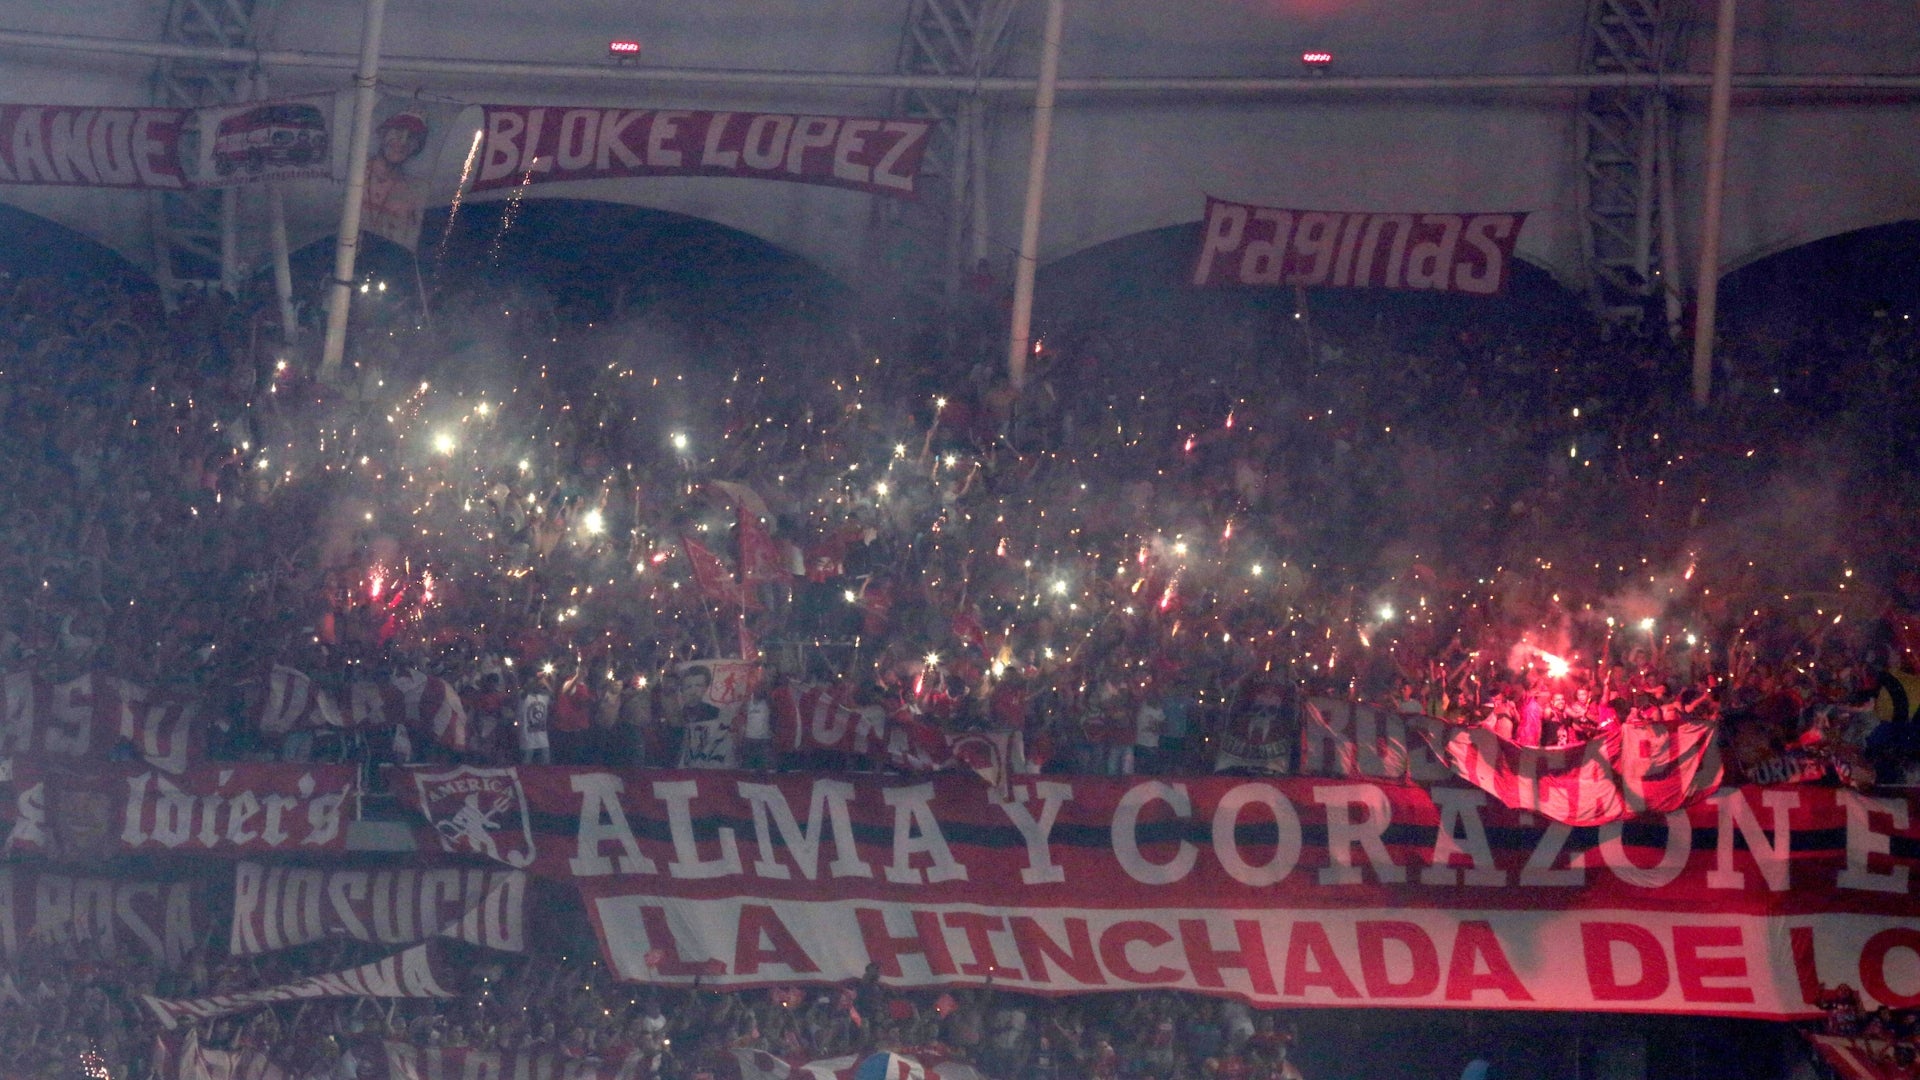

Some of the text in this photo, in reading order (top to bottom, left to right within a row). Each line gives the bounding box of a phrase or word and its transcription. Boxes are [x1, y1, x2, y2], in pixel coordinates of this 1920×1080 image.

[480, 108, 929, 192] BLOKE LOPEZ
[568, 772, 969, 885] ALMA
[987, 781, 1074, 886] Y
[1111, 780, 1801, 893] CORAZON
[230, 861, 527, 956] RIOSUCIO
[640, 903, 824, 977] LA
[854, 907, 1537, 1001] HINCHADA
[1580, 921, 1755, 1004] DE
